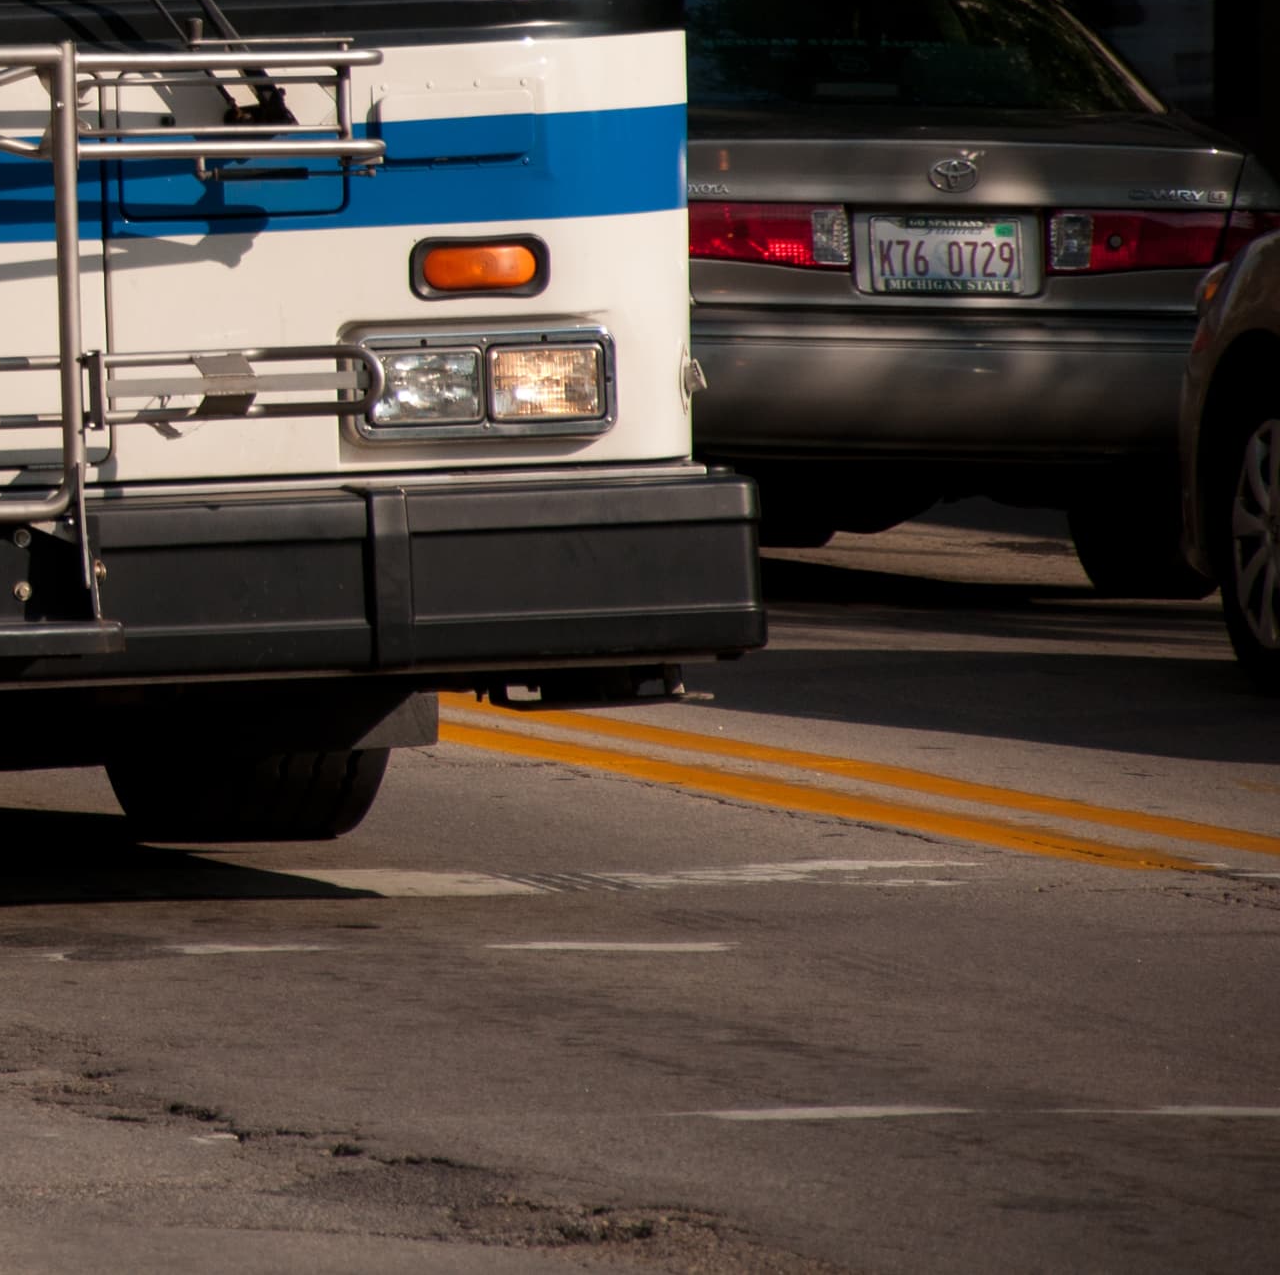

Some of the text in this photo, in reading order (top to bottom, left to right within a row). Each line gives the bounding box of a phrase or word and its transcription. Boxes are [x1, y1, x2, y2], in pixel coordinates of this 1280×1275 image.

[1128, 188, 1206, 202] CAMRY
[879, 240, 1016, 279] K76 0729
[889, 279, 1012, 291] MICHIGAN STATE
